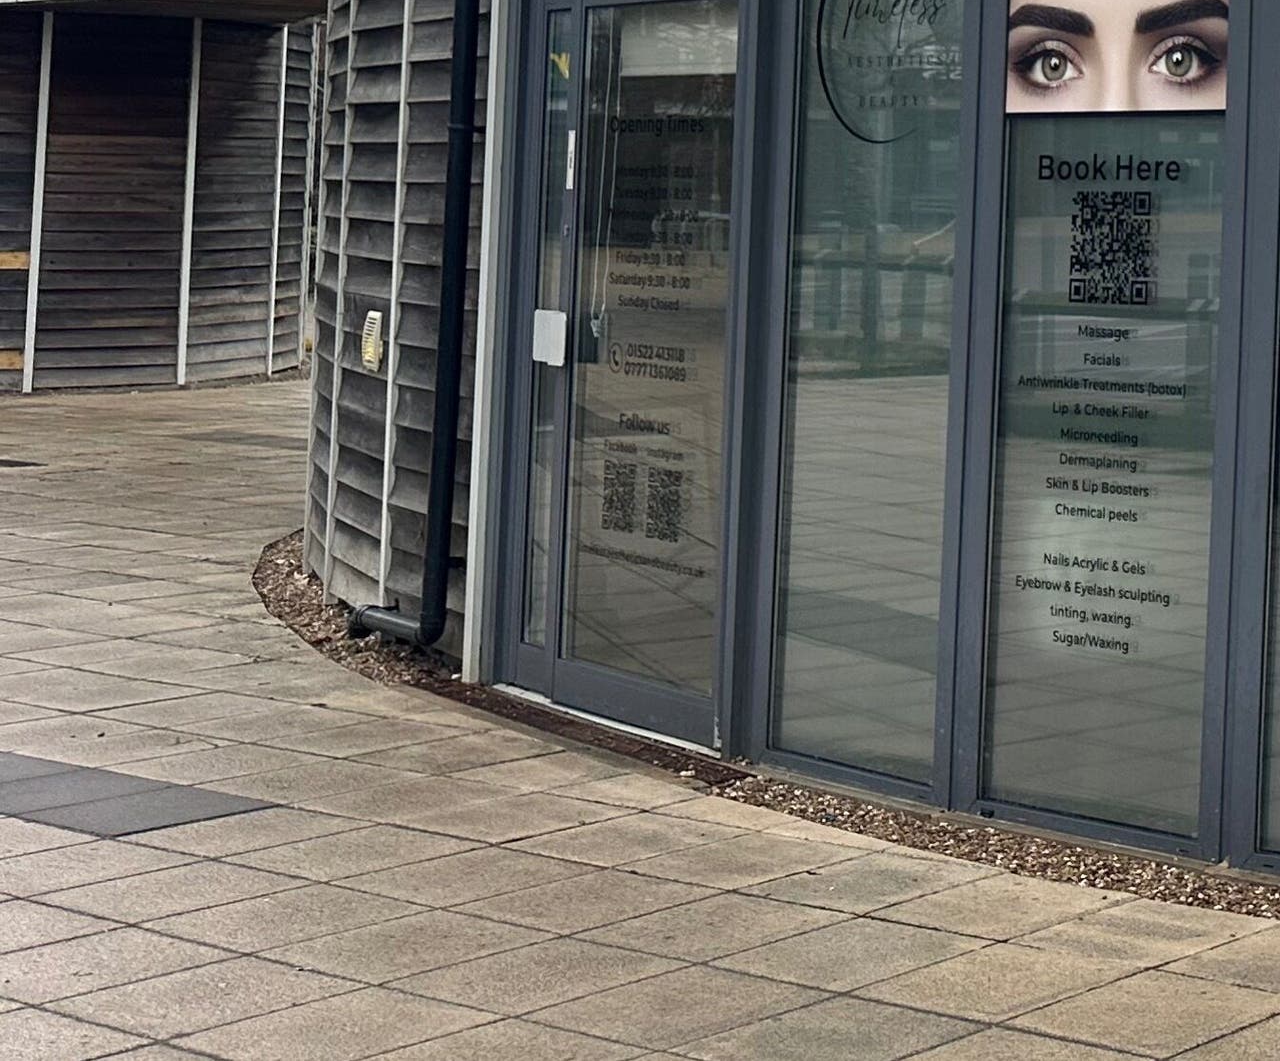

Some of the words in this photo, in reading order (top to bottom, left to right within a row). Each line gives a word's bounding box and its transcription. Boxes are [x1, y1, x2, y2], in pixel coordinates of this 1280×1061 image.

[610, 116, 662, 137] Opening
[665, 114, 704, 132] Times
[1038, 153, 1107, 180] Book
[1116, 155, 1181, 181] Here
[609, 271, 647, 289] Saturday
[618, 294, 649, 311] Sunday
[1078, 325, 1129, 342] Massage
[1084, 353, 1121, 366] Facials
[1018, 375, 1079, 390] Antiwrinkle
[1082, 378, 1145, 394] Treatments
[1148, 381, 1186, 399] (botox)
[1052, 402, 1068, 416] Lip
[1074, 404, 1081, 415] &
[1084, 404, 1119, 418] Cheek
[1122, 406, 1150, 419] Filler
[619, 413, 656, 432] Follow
[657, 421, 670, 435] us
[1060, 428, 1138, 447] Microneedling
[1060, 453, 1137, 473] Dermaplaning
[1046, 477, 1069, 489] Skin
[1072, 479, 1079, 491] &
[1082, 480, 1098, 495] Lip
[1101, 482, 1149, 497] Boosters
[1055, 503, 1106, 519] Chemical
[1108, 509, 1138, 522] peels
[1043, 553, 1070, 566] Nails
[1072, 556, 1109, 572] Acrylic
[1112, 561, 1119, 572] &
[1122, 562, 1146, 575] Gels
[1015, 575, 1062, 591] Eyebrow
[1064, 581, 1071, 592] &
[1074, 582, 1115, 597] Eyelash
[1118, 588, 1170, 607] sculpting
[1050, 605, 1088, 623] tinting,
[1052, 631, 1129, 654] Sugar/Waxing
